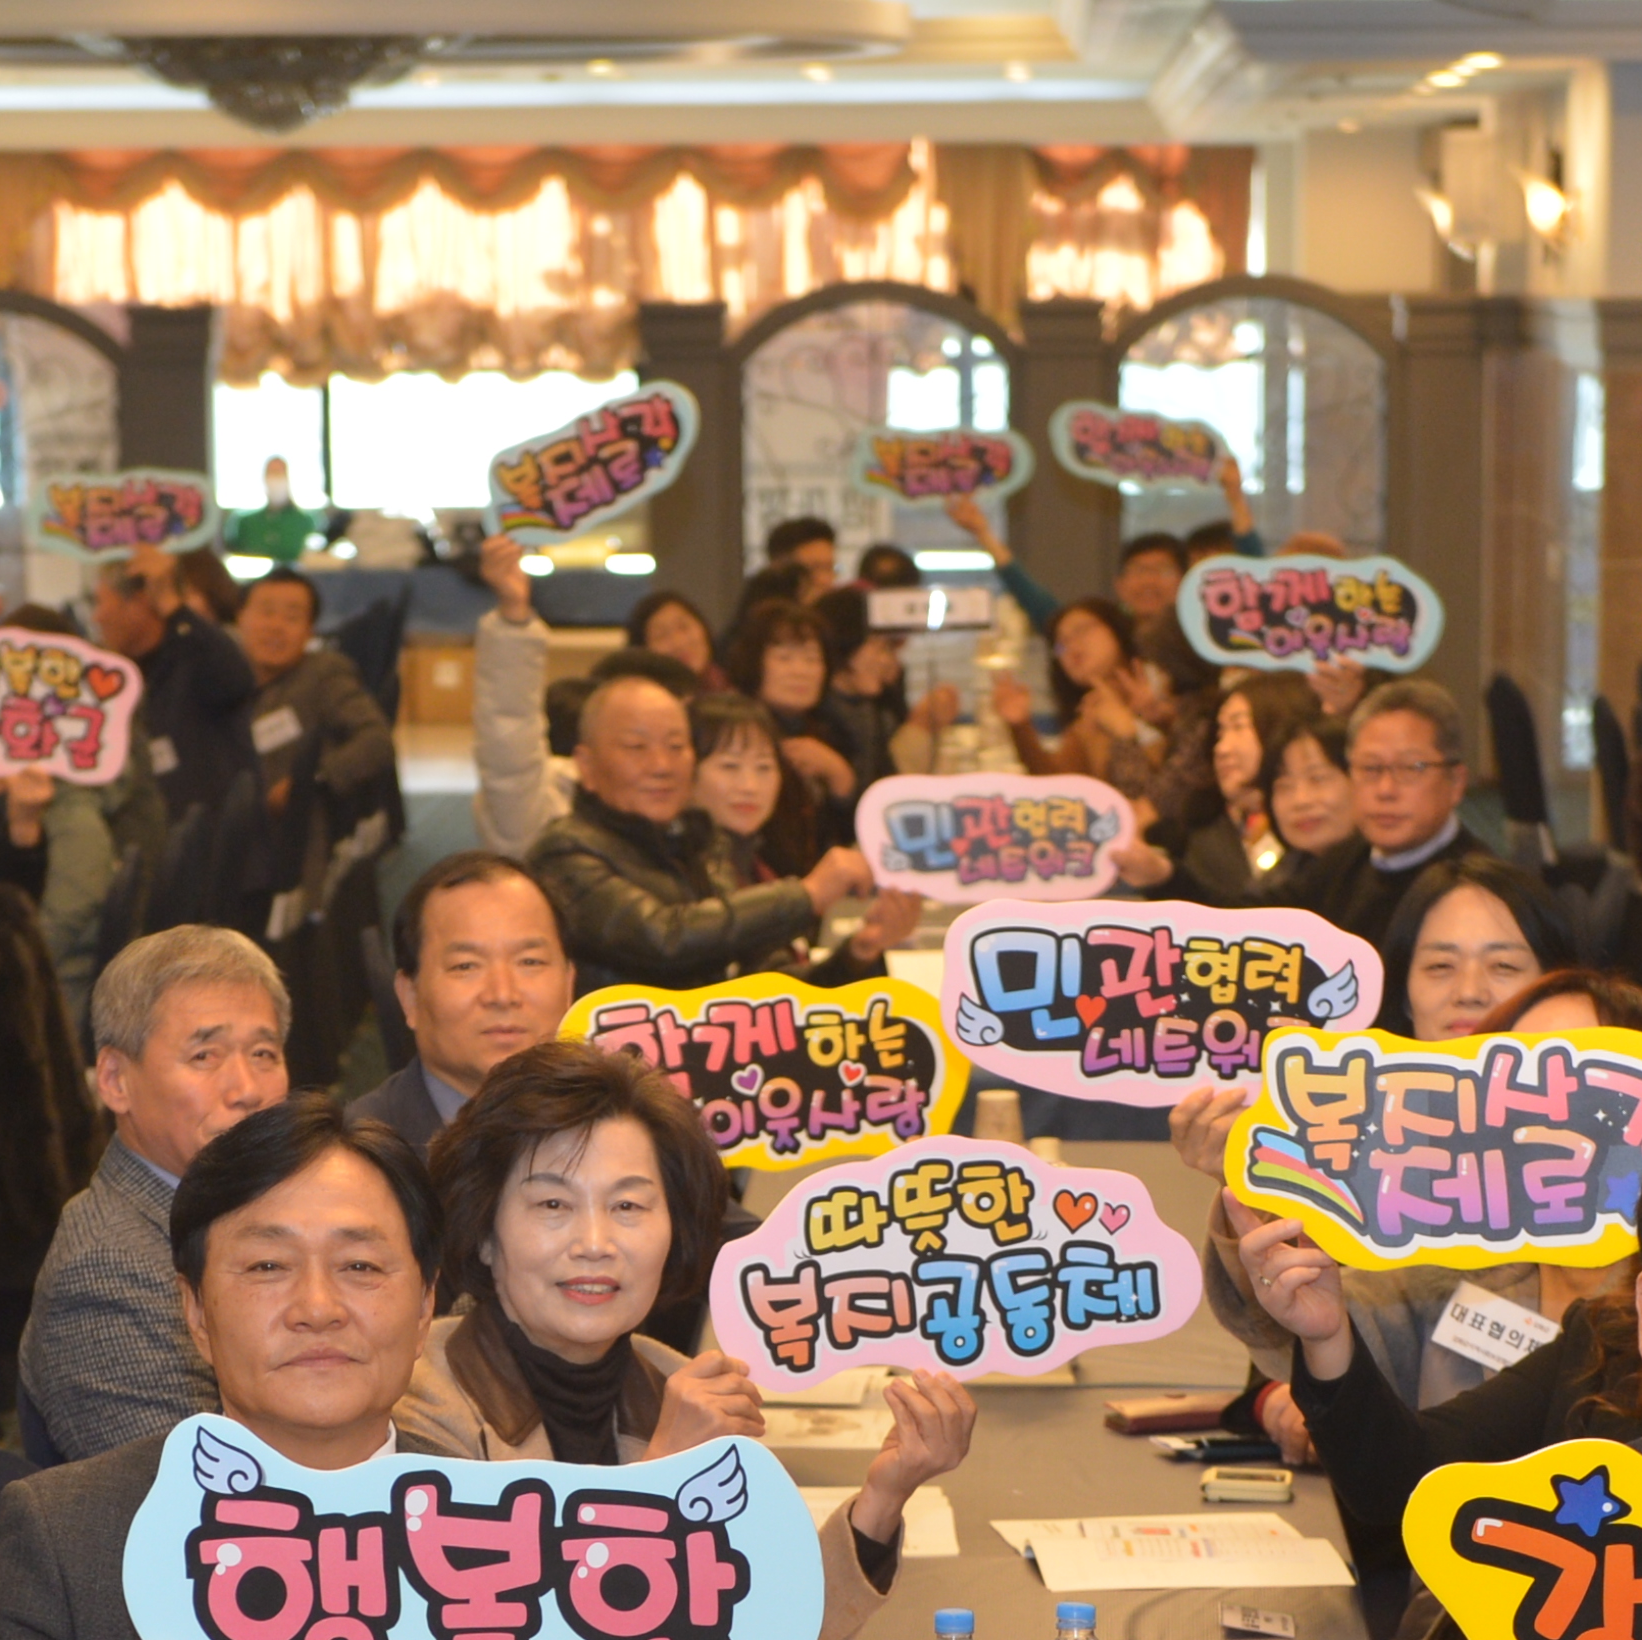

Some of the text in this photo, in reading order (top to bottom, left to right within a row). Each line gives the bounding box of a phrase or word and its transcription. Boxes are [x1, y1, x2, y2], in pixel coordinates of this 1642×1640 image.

[1201, 568, 1405, 632] 함께하는
[884, 794, 1089, 870] 민관협력
[957, 838, 1096, 886] 네트워크
[970, 924, 1306, 1042] 민관협력
[1080, 1006, 1311, 1079] 네트워
[700, 1073, 927, 1154] 이웃사랑
[805, 1159, 1035, 1255] 따뜻한
[1365, 1124, 1599, 1241] 제로
[740, 1241, 1160, 1373] 복지공동체
